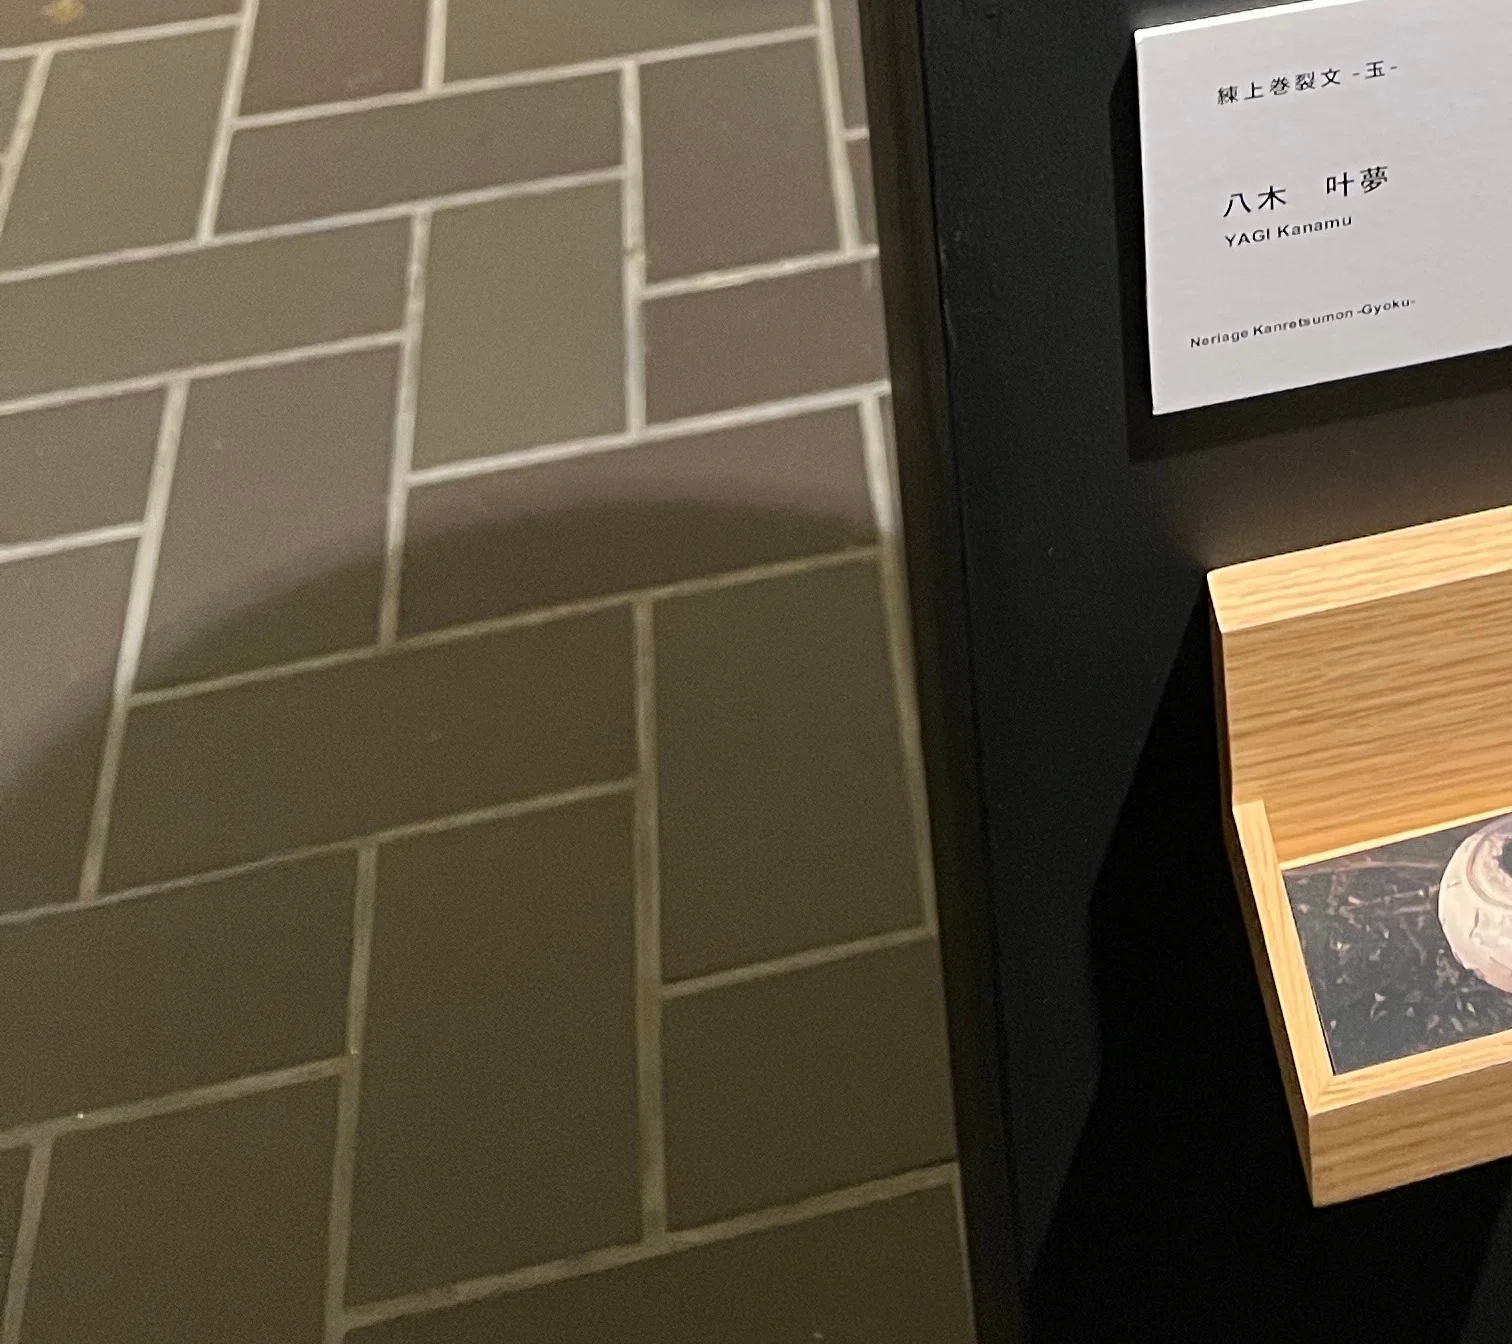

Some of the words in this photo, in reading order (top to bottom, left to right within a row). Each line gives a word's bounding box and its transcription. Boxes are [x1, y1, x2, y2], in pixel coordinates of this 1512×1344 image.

[1223, 185, 1287, 218] 八木
[1224, 227, 1270, 248] YAGI
[1276, 215, 1352, 239] Kanamu
[1190, 328, 1249, 349] Neriage
[1252, 309, 1354, 337] Kanretsumon
